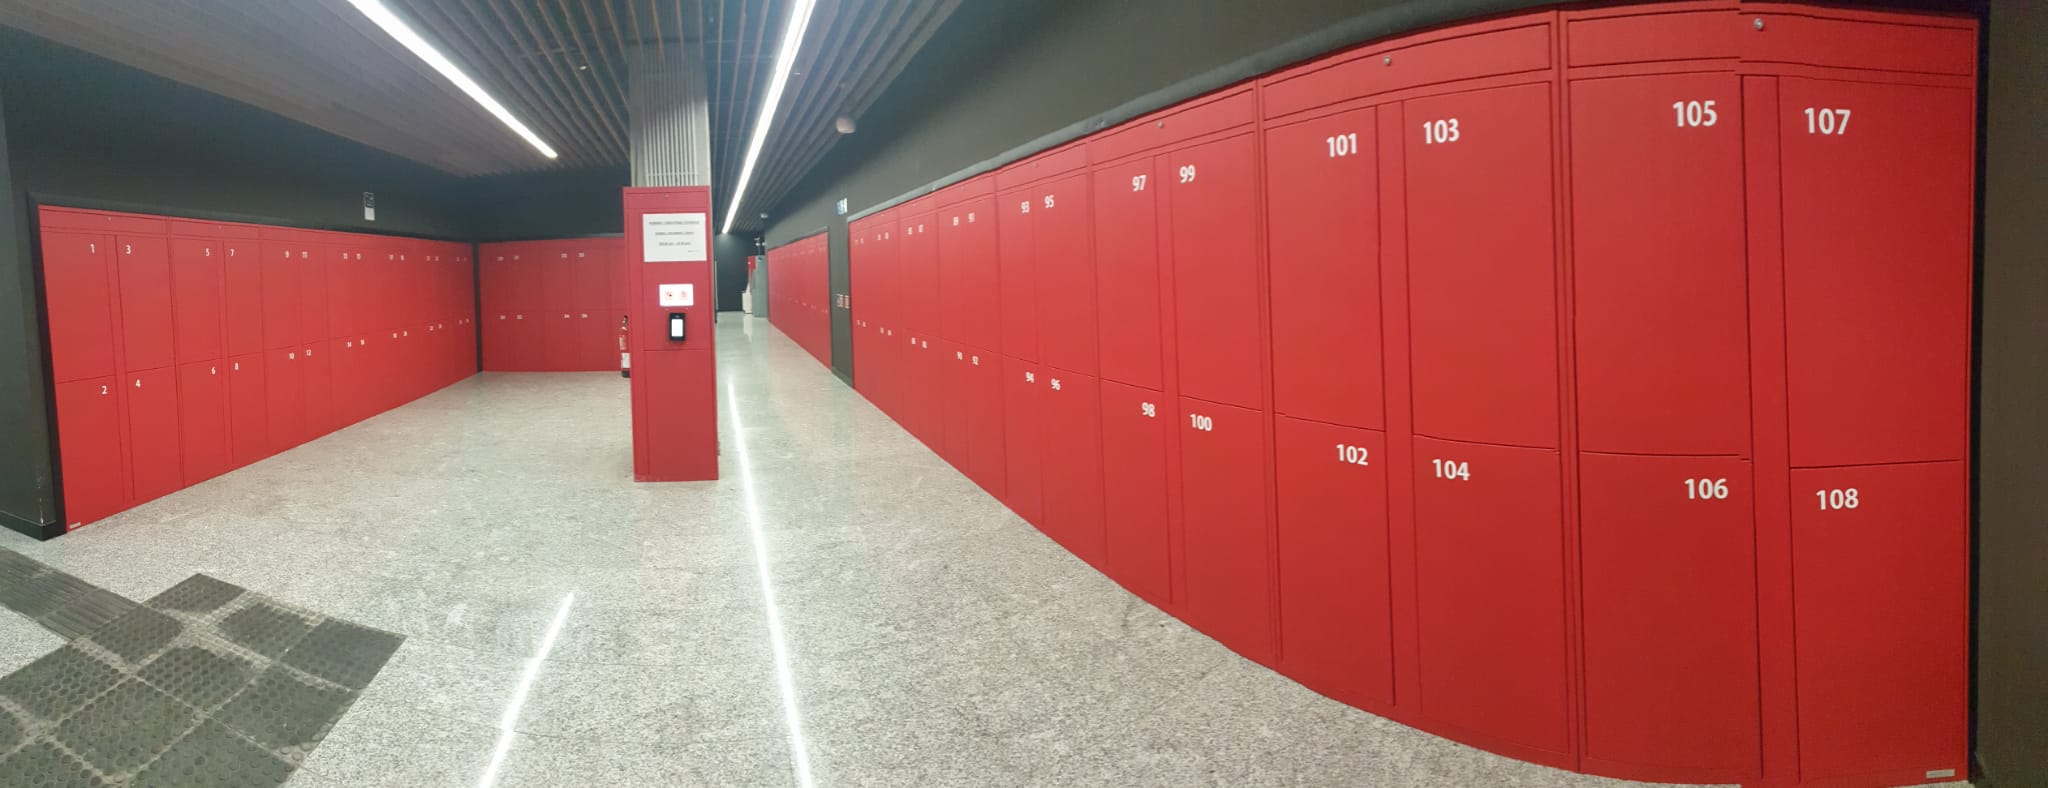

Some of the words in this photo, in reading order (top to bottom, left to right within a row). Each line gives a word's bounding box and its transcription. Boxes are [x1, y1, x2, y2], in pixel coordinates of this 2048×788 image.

[1672, 100, 1718, 128] 105
[1804, 107, 1851, 135] 107
[1423, 117, 1460, 145] 103
[1326, 132, 1357, 158] 101
[1179, 164, 1196, 184] 99
[1131, 174, 1147, 192] 97
[1020, 200, 1030, 214] 93
[1044, 194, 1055, 209] 95
[89, 243, 95, 254] 1
[125, 244, 132, 255] 3
[205, 247, 210, 257] 5
[230, 248, 235, 257] 7
[288, 351, 295, 360] 10
[305, 348, 312, 357] 12
[211, 366, 216, 375] 6
[234, 362, 239, 371] 8
[101, 385, 108, 395] 2
[135, 379, 141, 388] 4
[1050, 378, 1061, 391] 96
[1141, 401, 1156, 418] 98
[1189, 413, 1213, 432] 100
[1336, 443, 1369, 466] 102
[1432, 458, 1471, 481] 104
[1684, 478, 1729, 500] 106
[1816, 487, 1859, 511] 108
